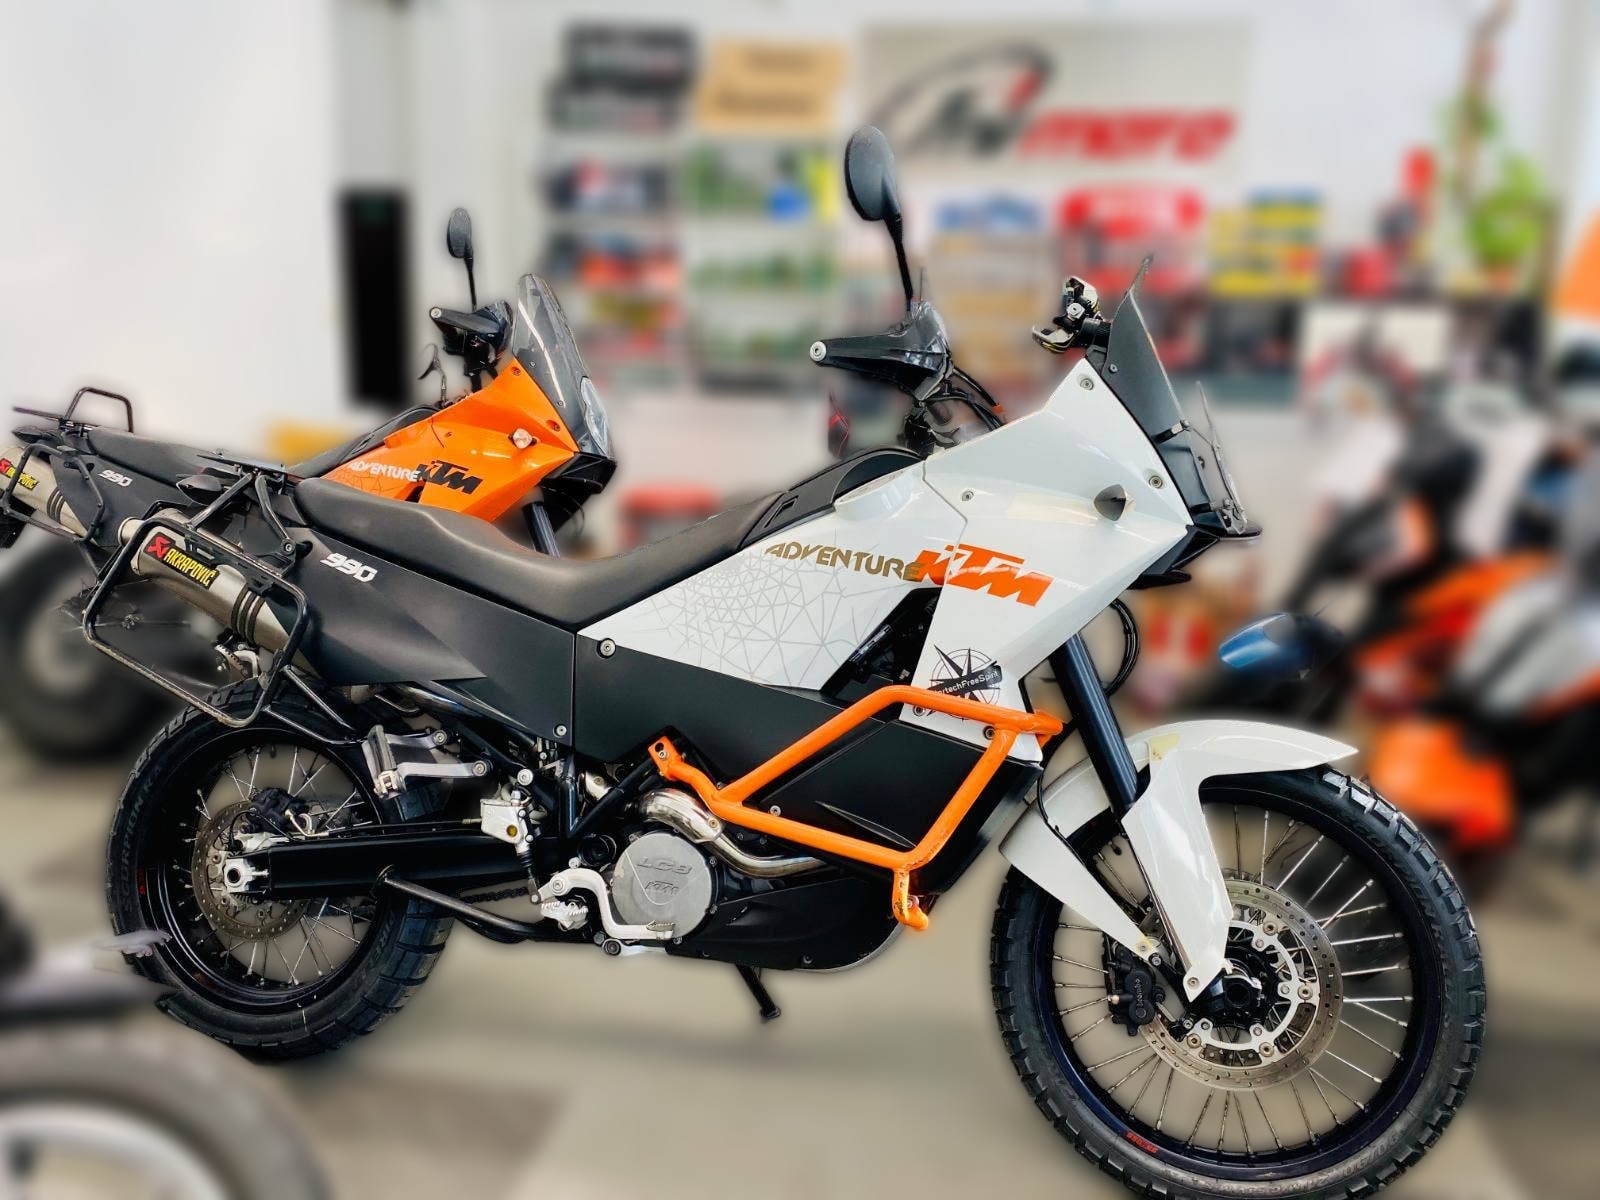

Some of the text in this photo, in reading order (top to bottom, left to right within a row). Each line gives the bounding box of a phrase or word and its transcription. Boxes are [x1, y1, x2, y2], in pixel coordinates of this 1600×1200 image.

[98, 470, 132, 487] 990
[348, 460, 483, 494] ADVENTURE KTM
[320, 553, 378, 582] 990
[764, 541, 1054, 607] ADVENTURE KTM
